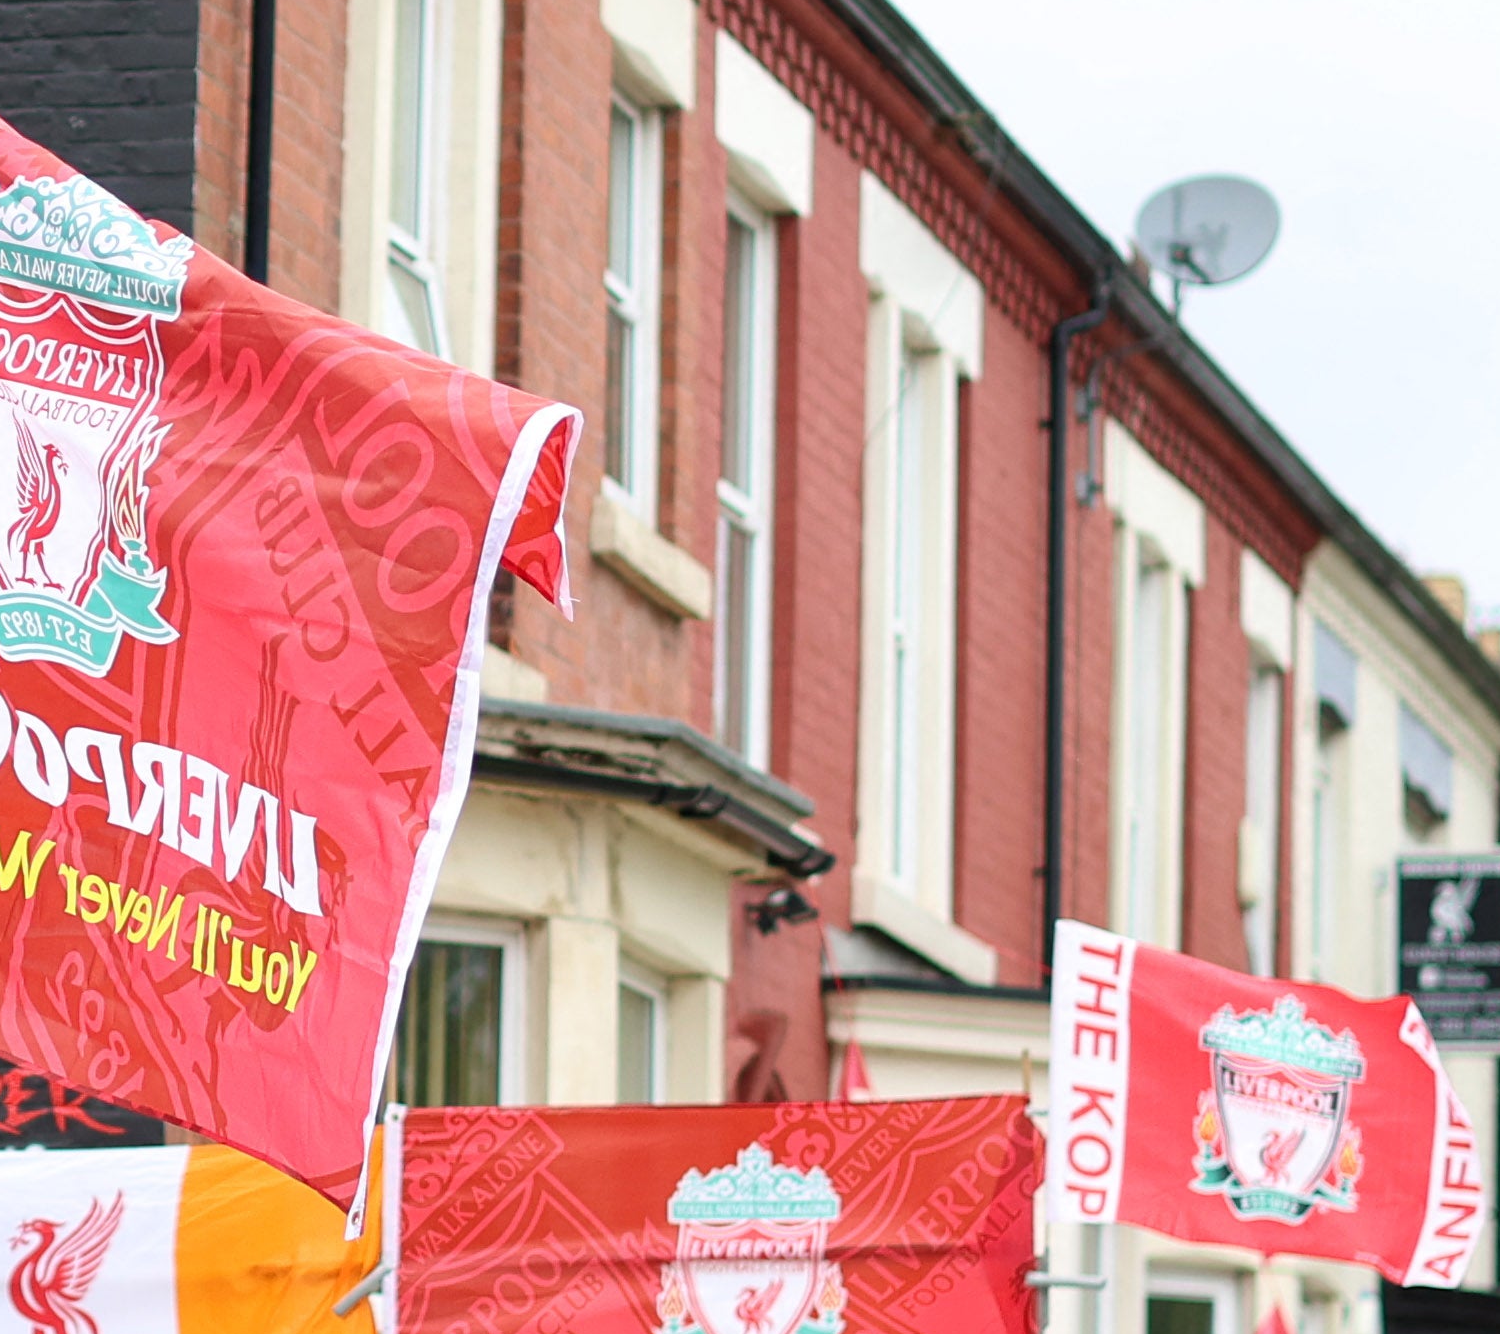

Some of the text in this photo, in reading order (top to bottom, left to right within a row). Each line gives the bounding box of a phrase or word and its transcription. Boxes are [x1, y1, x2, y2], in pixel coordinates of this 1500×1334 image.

[1066, 943, 1123, 1217] THE KOP
[1223, 1069, 1338, 1112] LIVERPOOL
[468, 1129, 547, 1216] ALONE
[690, 1238, 812, 1259] LIVERPOOL
